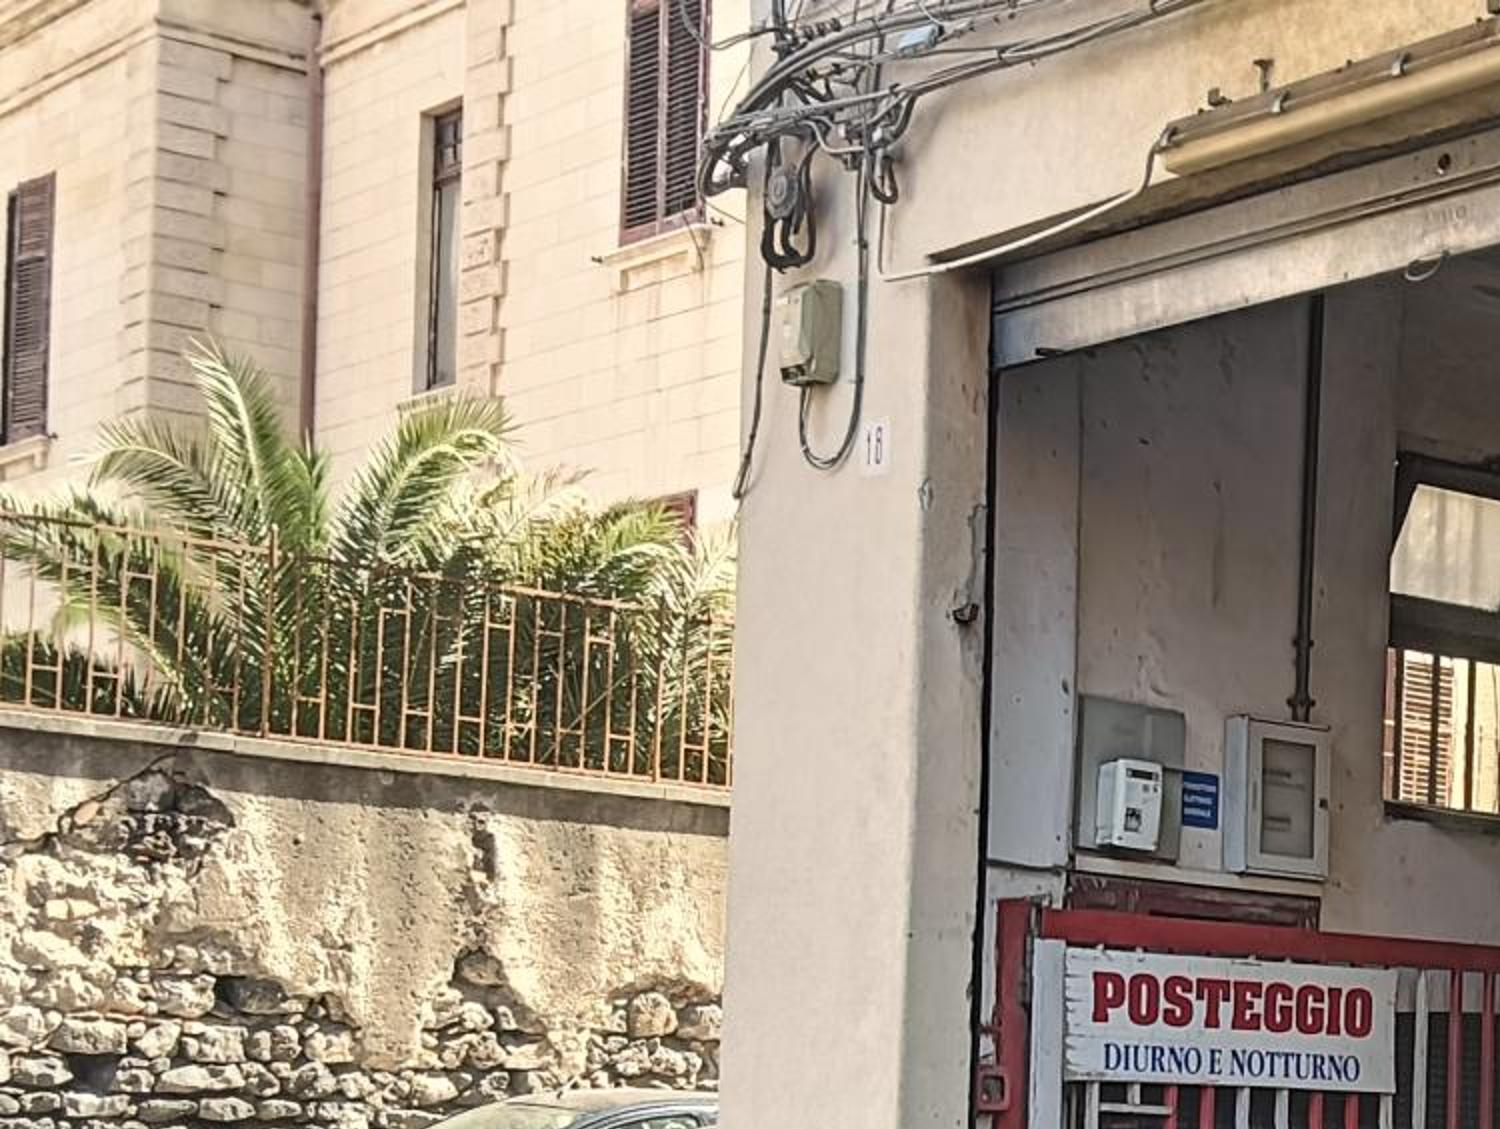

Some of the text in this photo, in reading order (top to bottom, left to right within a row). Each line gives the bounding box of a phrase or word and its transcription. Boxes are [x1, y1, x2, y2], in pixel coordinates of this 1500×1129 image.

[1091, 970, 1374, 1038] POSTEGGIO
[1104, 1043, 1361, 1082] DIURNO E NOTTURNO
